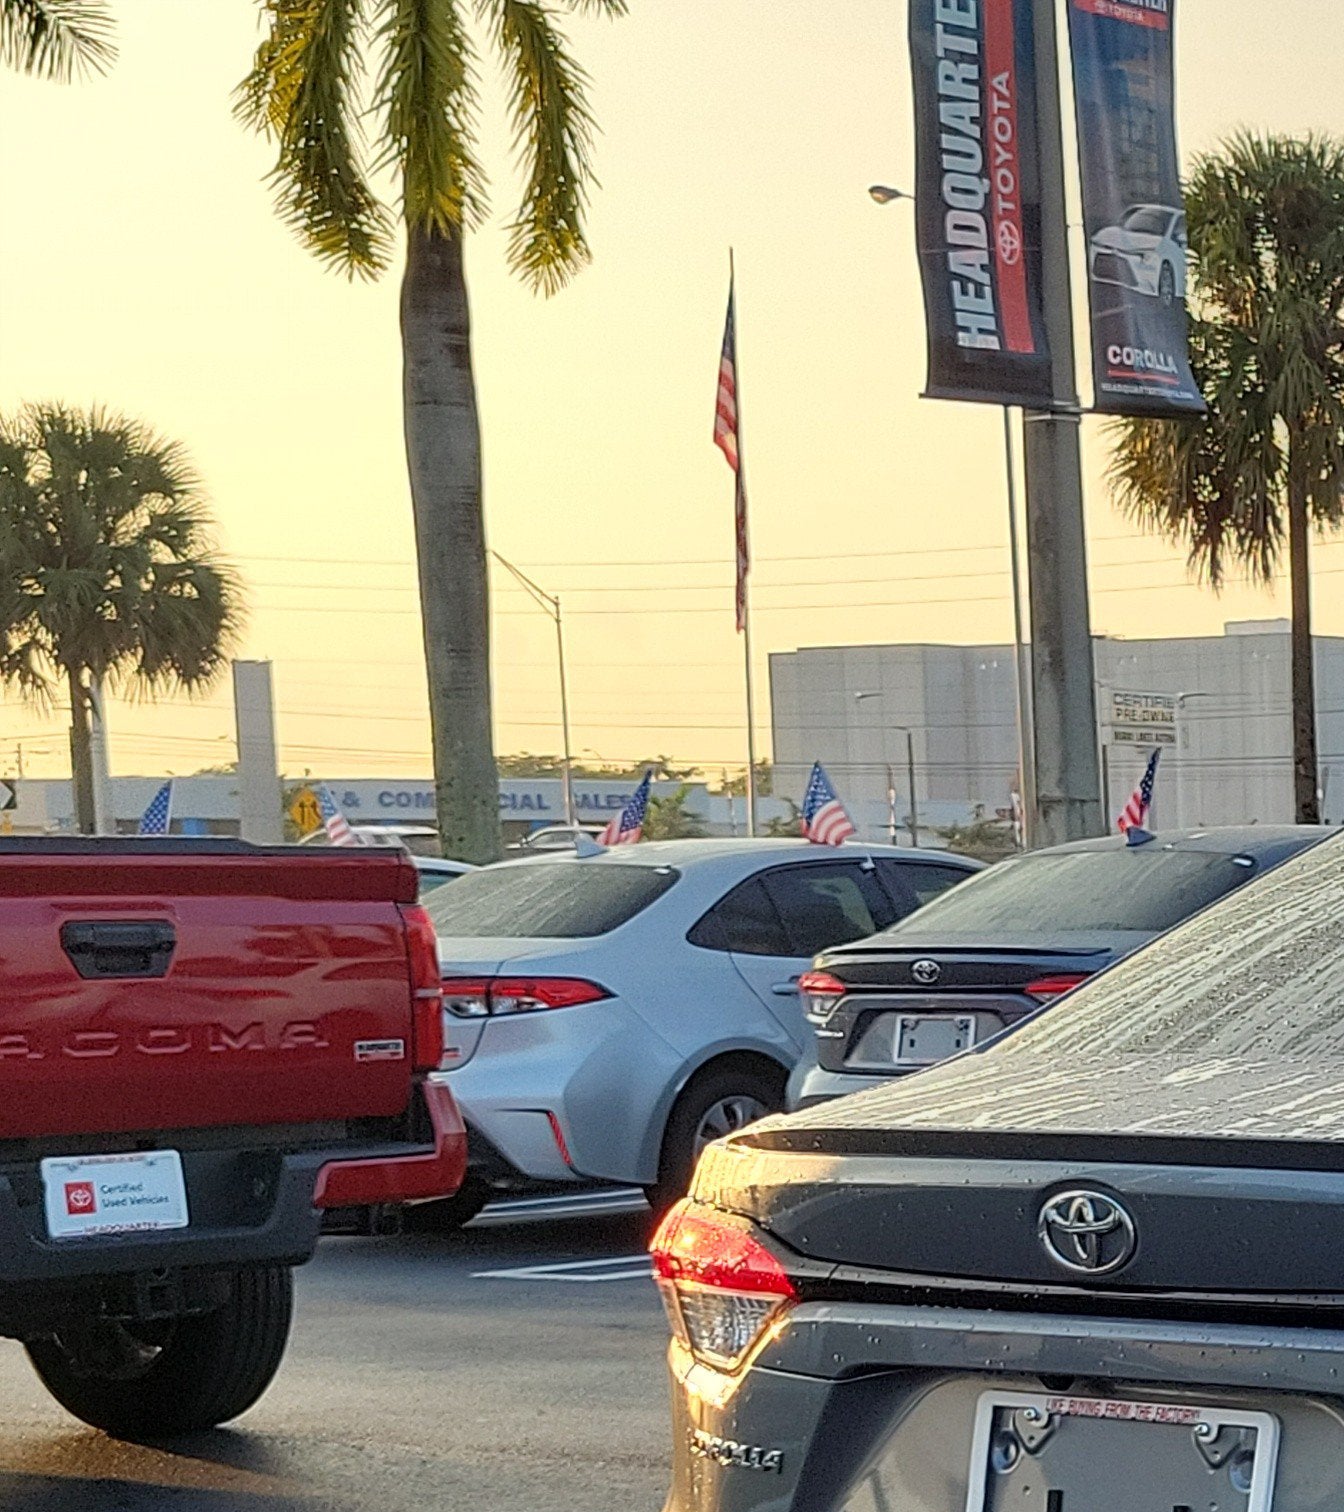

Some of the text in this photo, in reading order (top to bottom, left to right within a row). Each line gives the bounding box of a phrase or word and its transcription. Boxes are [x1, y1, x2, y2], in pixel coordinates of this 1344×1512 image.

[991, 70, 1016, 214] TOYOTA
[934, 0, 1001, 351] HEADQUARTE
[1107, 345, 1179, 374] COROLLA
[341, 791, 361, 808] &
[378, 790, 551, 810] COMCIAL
[0, 1020, 330, 1060] ACOMA
[100, 1182, 144, 1194] Certified
[101, 1198, 126, 1208] Used
